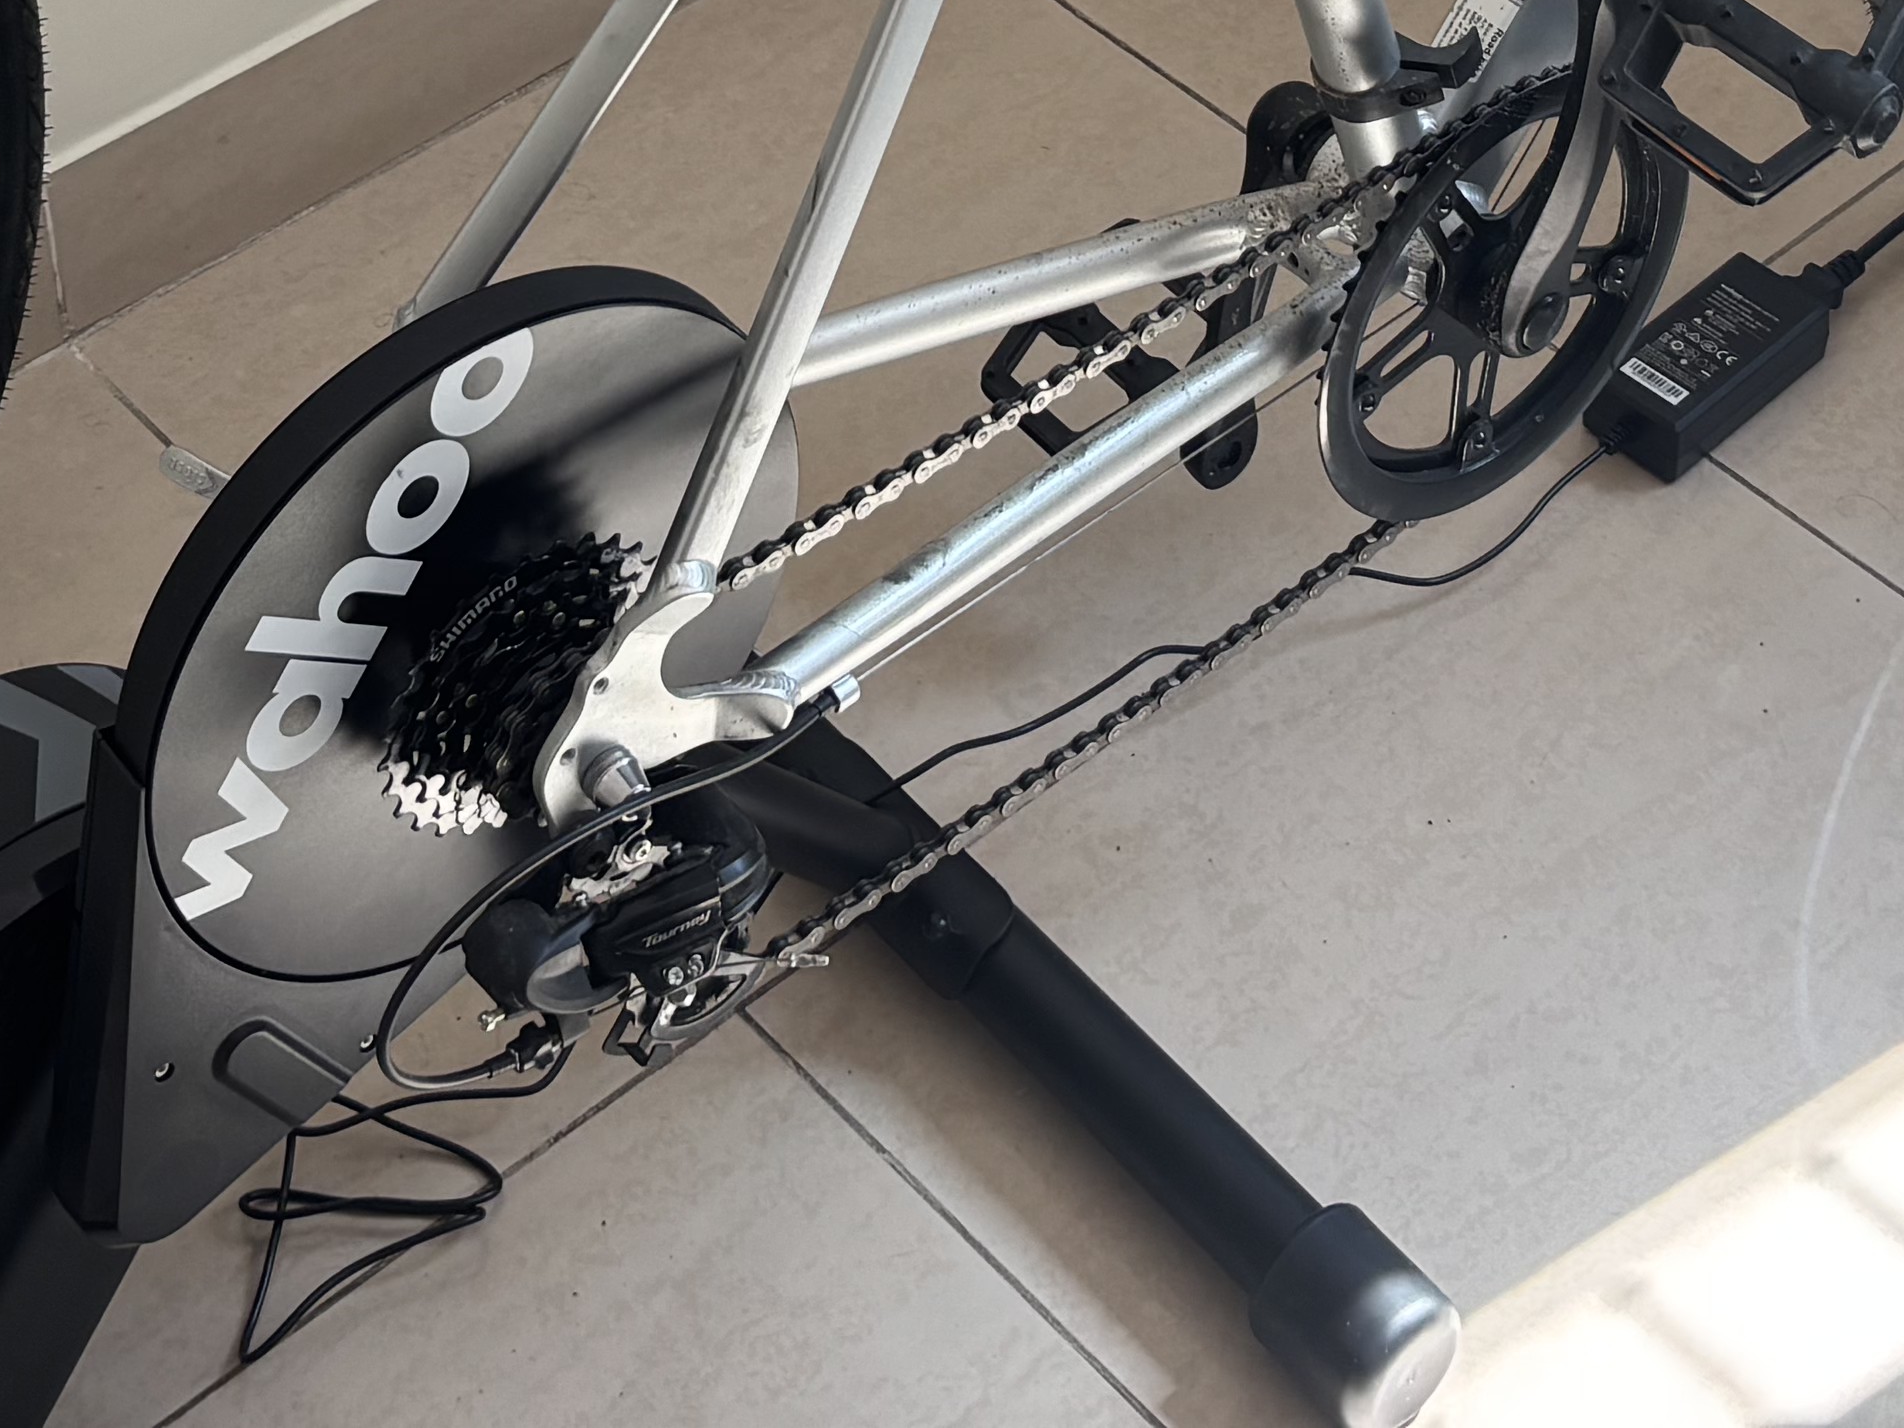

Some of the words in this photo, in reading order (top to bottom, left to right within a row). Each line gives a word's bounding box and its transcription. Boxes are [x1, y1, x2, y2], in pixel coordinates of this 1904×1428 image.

[174, 327, 534, 921] wahoo
[430, 576, 517, 663] SHIMANO
[642, 910, 712, 948] Tourney
